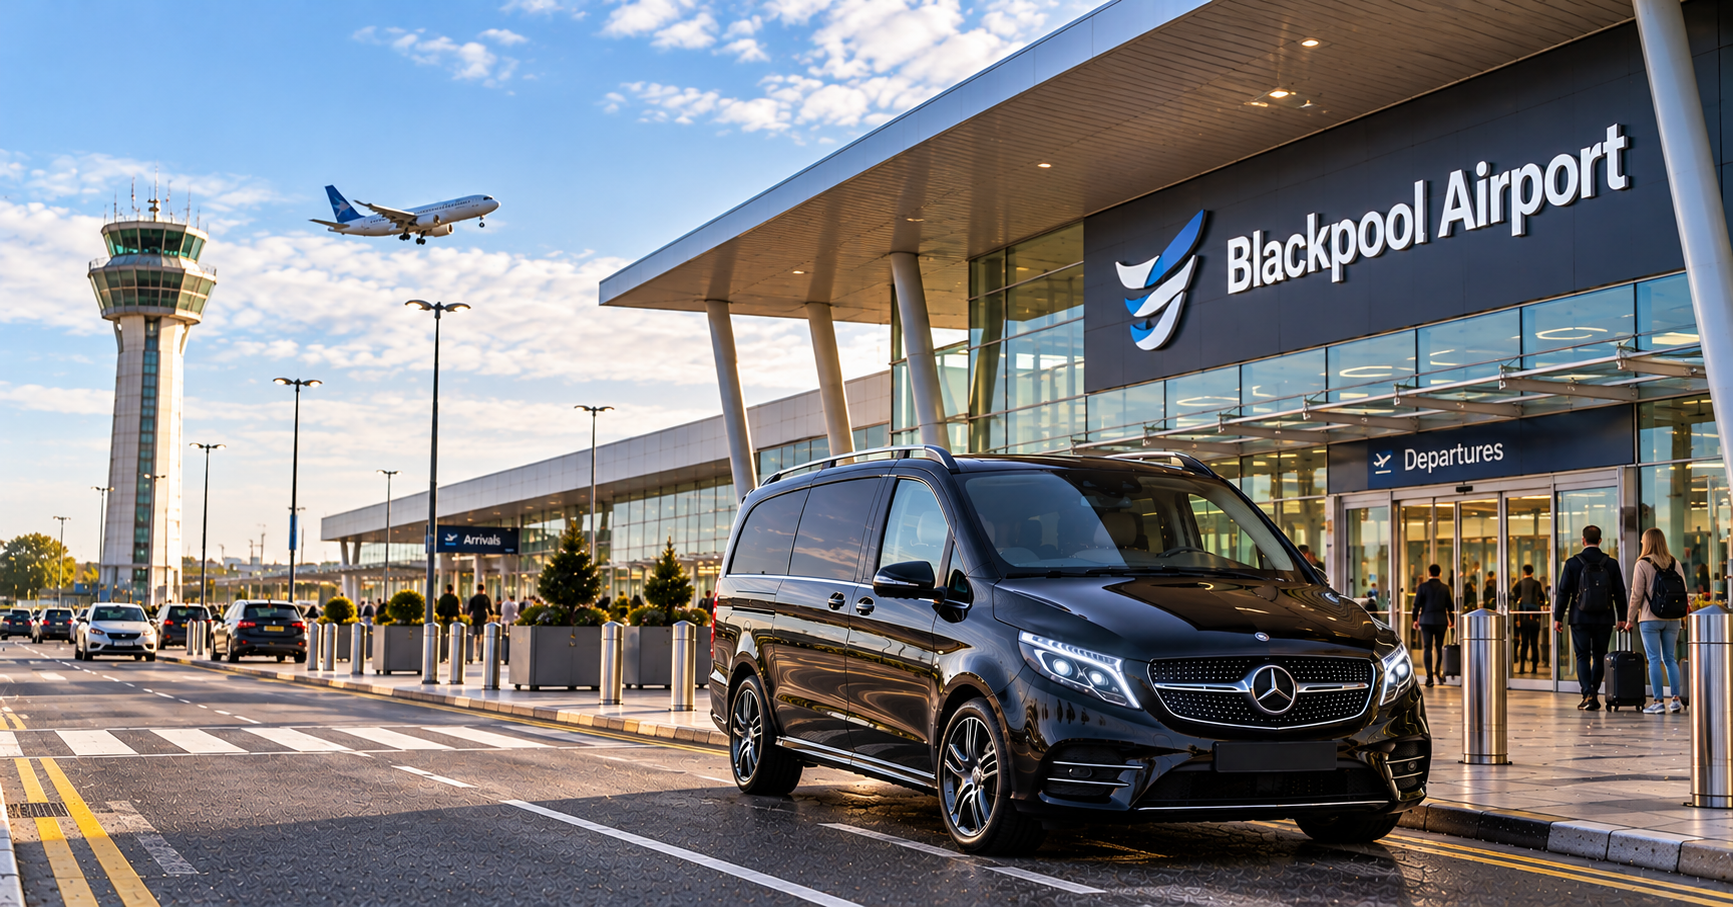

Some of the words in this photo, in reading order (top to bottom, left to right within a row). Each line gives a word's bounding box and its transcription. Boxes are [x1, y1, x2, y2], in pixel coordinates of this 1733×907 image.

[1227, 179, 1428, 294] Blackpool
[1438, 123, 1629, 238] Airport
[1404, 442, 1504, 474] Departures
[463, 534, 501, 546] Arrivals
